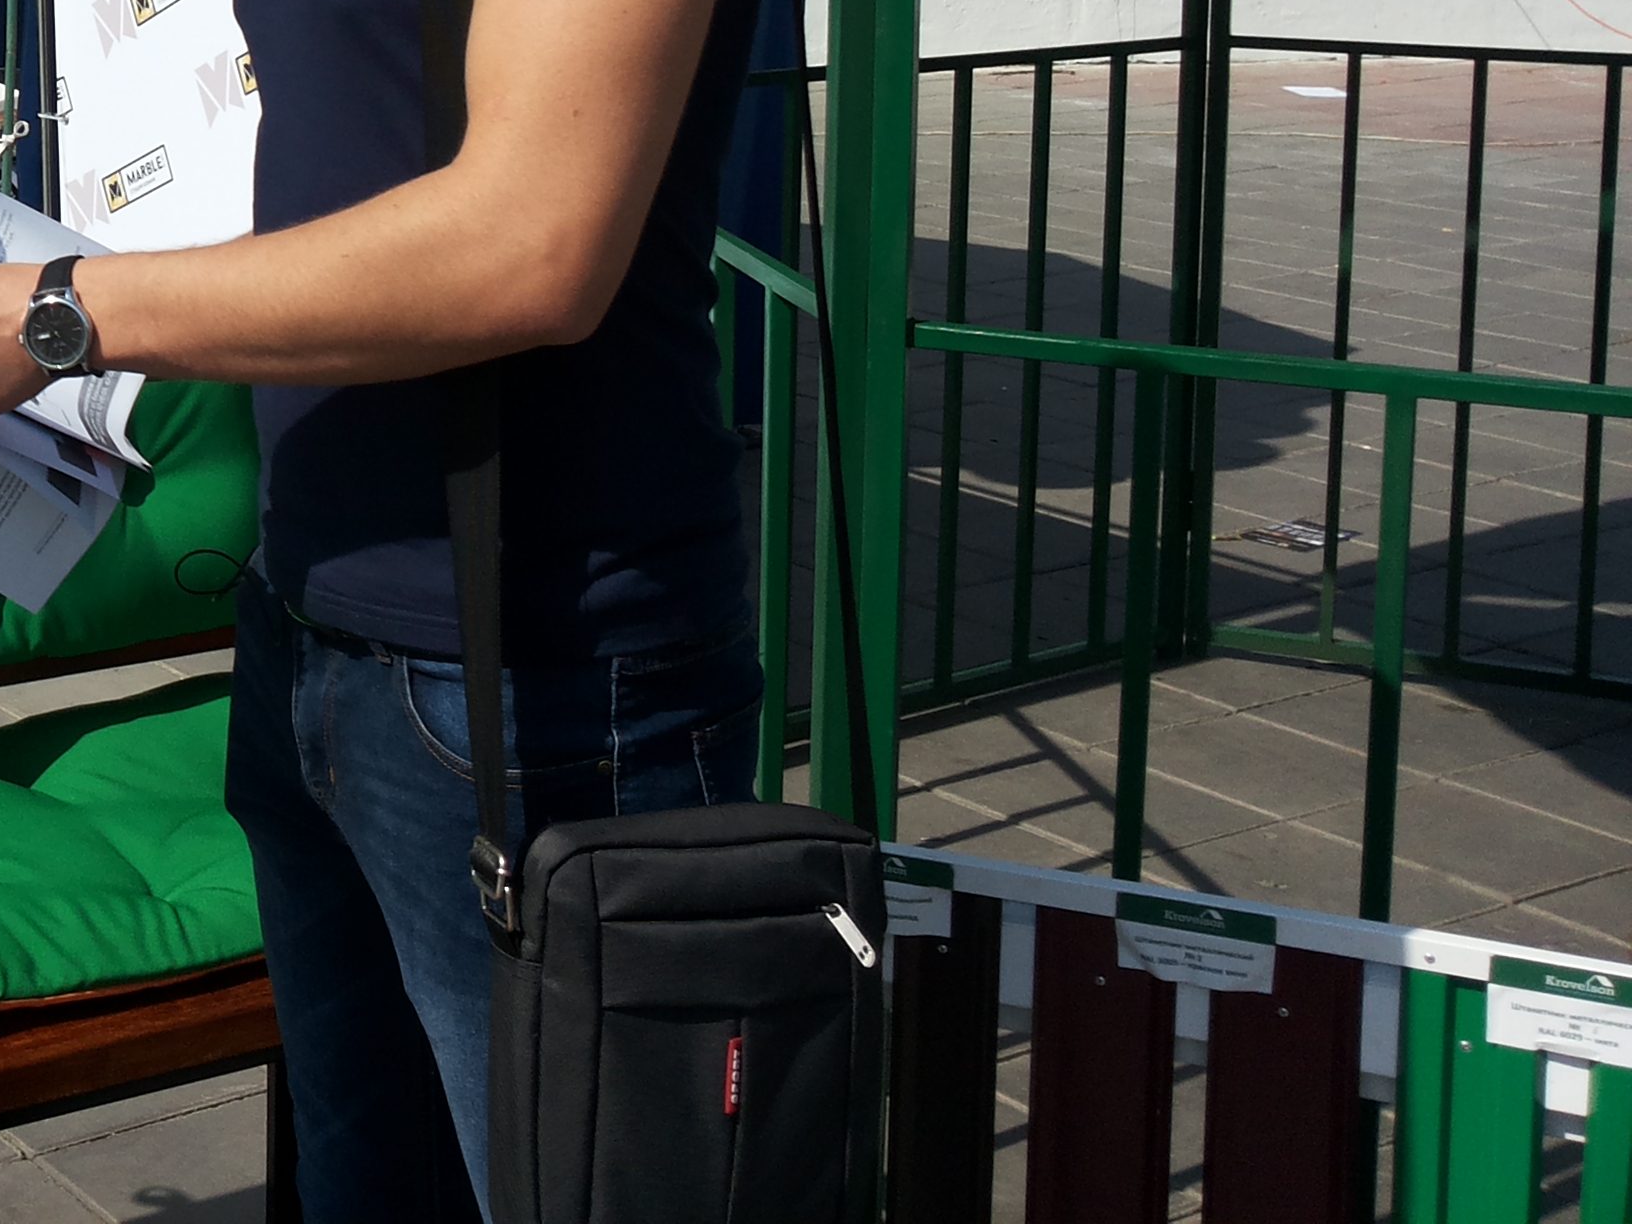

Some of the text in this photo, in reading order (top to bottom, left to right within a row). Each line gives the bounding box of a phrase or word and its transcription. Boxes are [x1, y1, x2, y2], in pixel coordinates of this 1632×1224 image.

[126, 155, 164, 186] MARBLE
[1164, 910, 1225, 928] Krovelson
[1545, 975, 1615, 996] Krovelson
